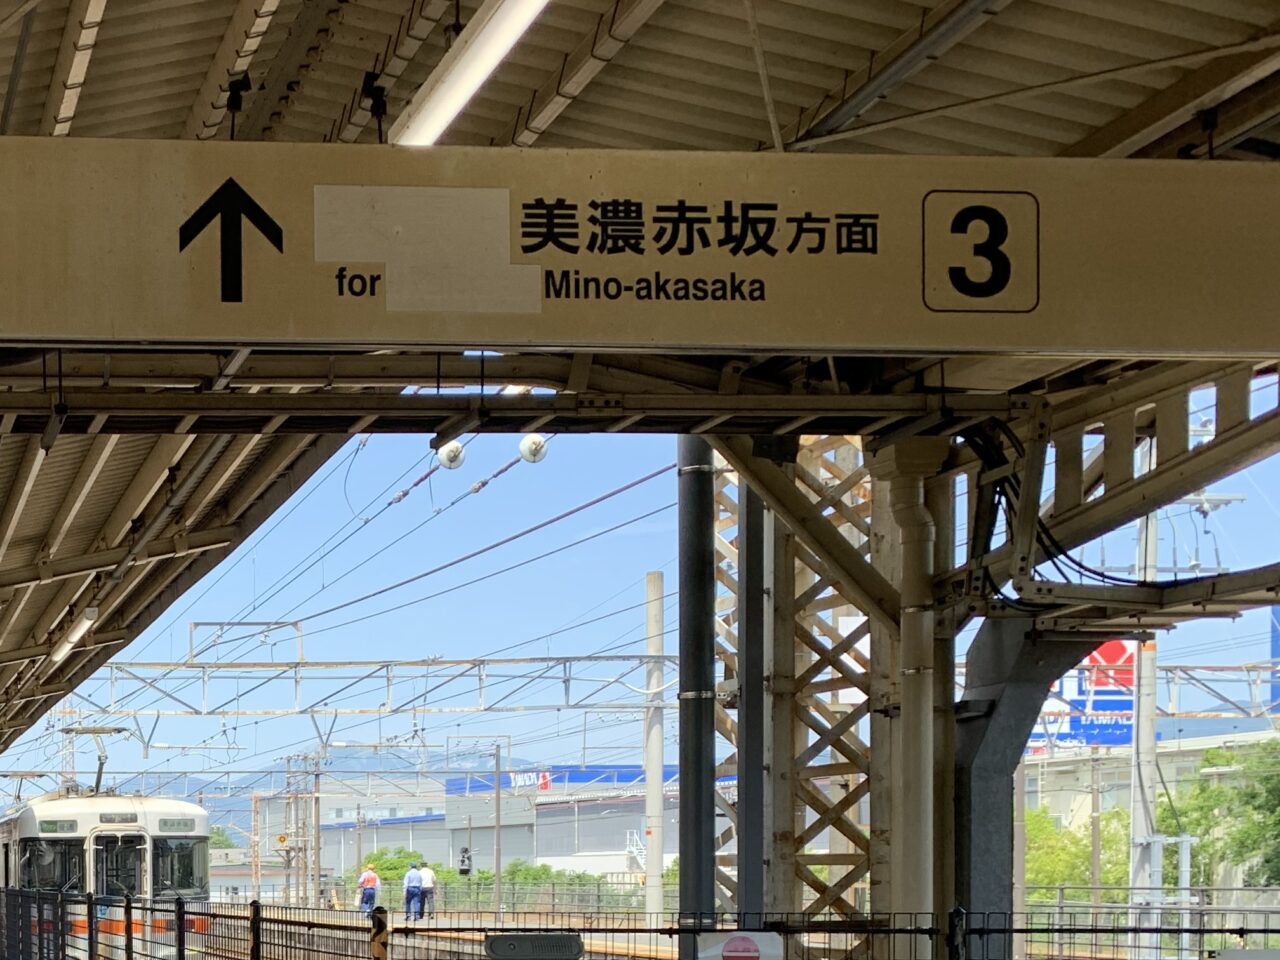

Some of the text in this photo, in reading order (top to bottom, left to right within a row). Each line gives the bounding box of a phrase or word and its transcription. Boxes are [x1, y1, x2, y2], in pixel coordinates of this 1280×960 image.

[520, 197, 879, 257] 美濃赤坂方面
[948, 205, 1011, 298] 3
[335, 266, 766, 301] for Mino-akasaka
